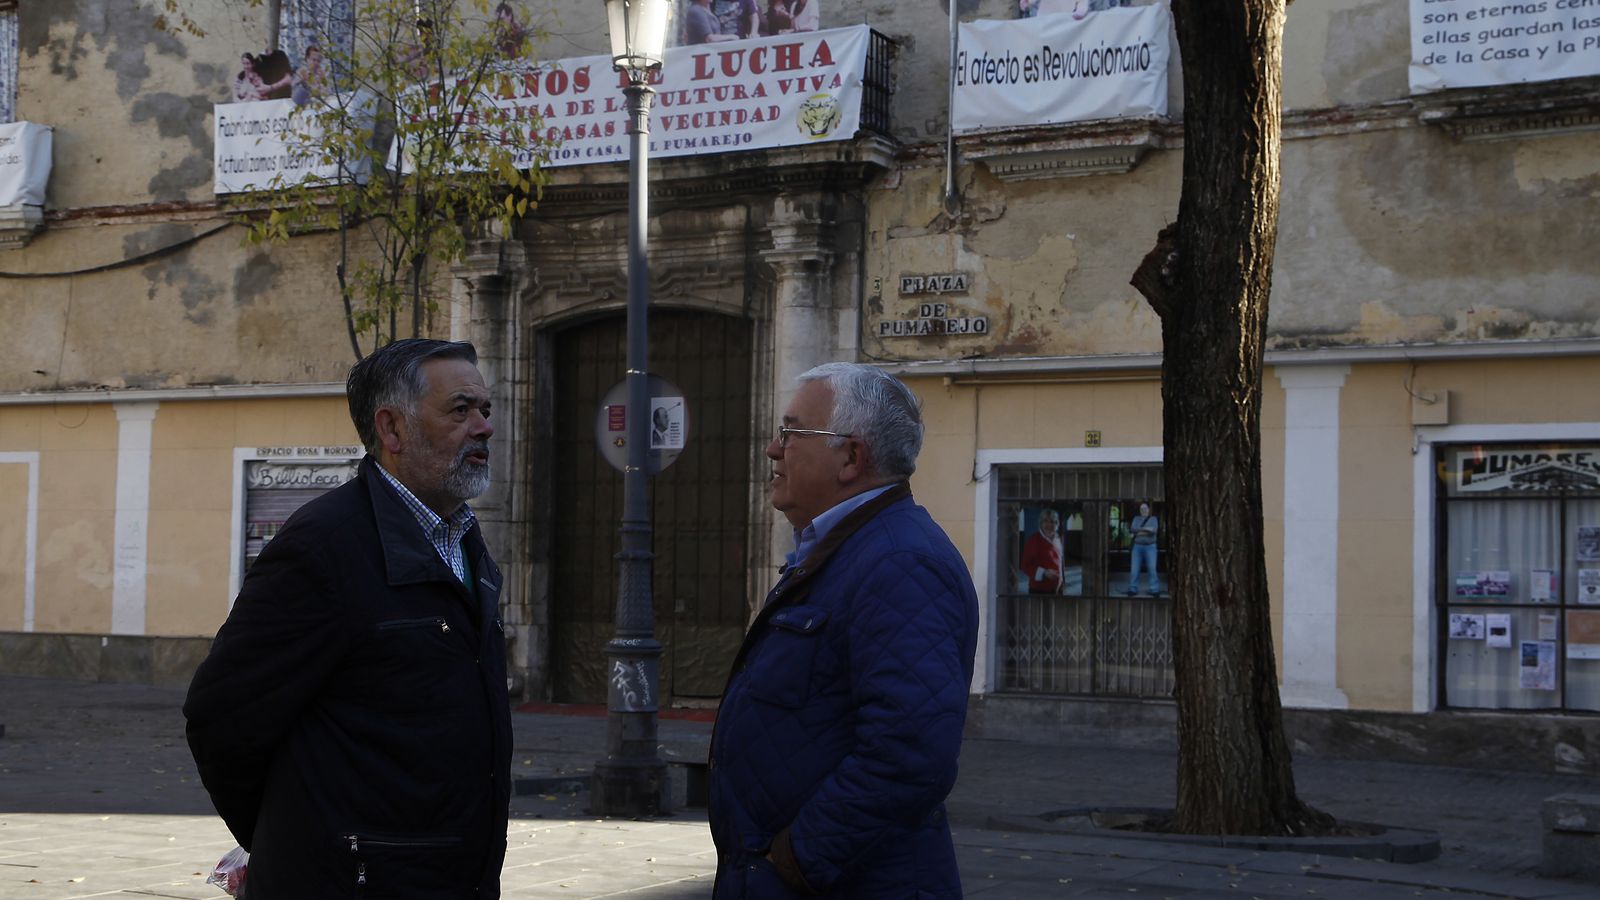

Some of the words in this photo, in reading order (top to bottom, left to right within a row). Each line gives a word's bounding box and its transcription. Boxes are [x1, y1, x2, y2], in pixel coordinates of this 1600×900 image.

[1423, 11, 1458, 24] son
[1465, 1, 1548, 21] eternas
[1555, 0, 1600, 9] cen
[1422, 30, 1470, 45] ellas
[1477, 21, 1564, 45] guardan
[1572, 16, 1600, 31] las
[690, 39, 836, 82] LUCHA
[957, 50, 968, 86] El
[970, 49, 1019, 85] afecto
[1023, 54, 1040, 83] es
[1042, 36, 1151, 82] Revolucionario
[1422, 52, 1448, 66] de
[1455, 50, 1473, 64] la
[1480, 47, 1530, 61] Casa
[1537, 45, 1549, 60] y
[1557, 40, 1575, 54] la
[566, 99, 595, 117] DE
[777, 73, 842, 96] VIVA
[499, 129, 538, 146] LS
[546, 121, 616, 143] CASAS
[660, 105, 781, 132] VECINDAD
[586, 145, 622, 158] CASA
[664, 132, 753, 151] PUMAREJO
[902, 276, 965, 292] PLAZA
[920, 304, 945, 318] DE
[879, 319, 986, 336] PUMAEJO
[260, 466, 342, 487] Biblioteca
